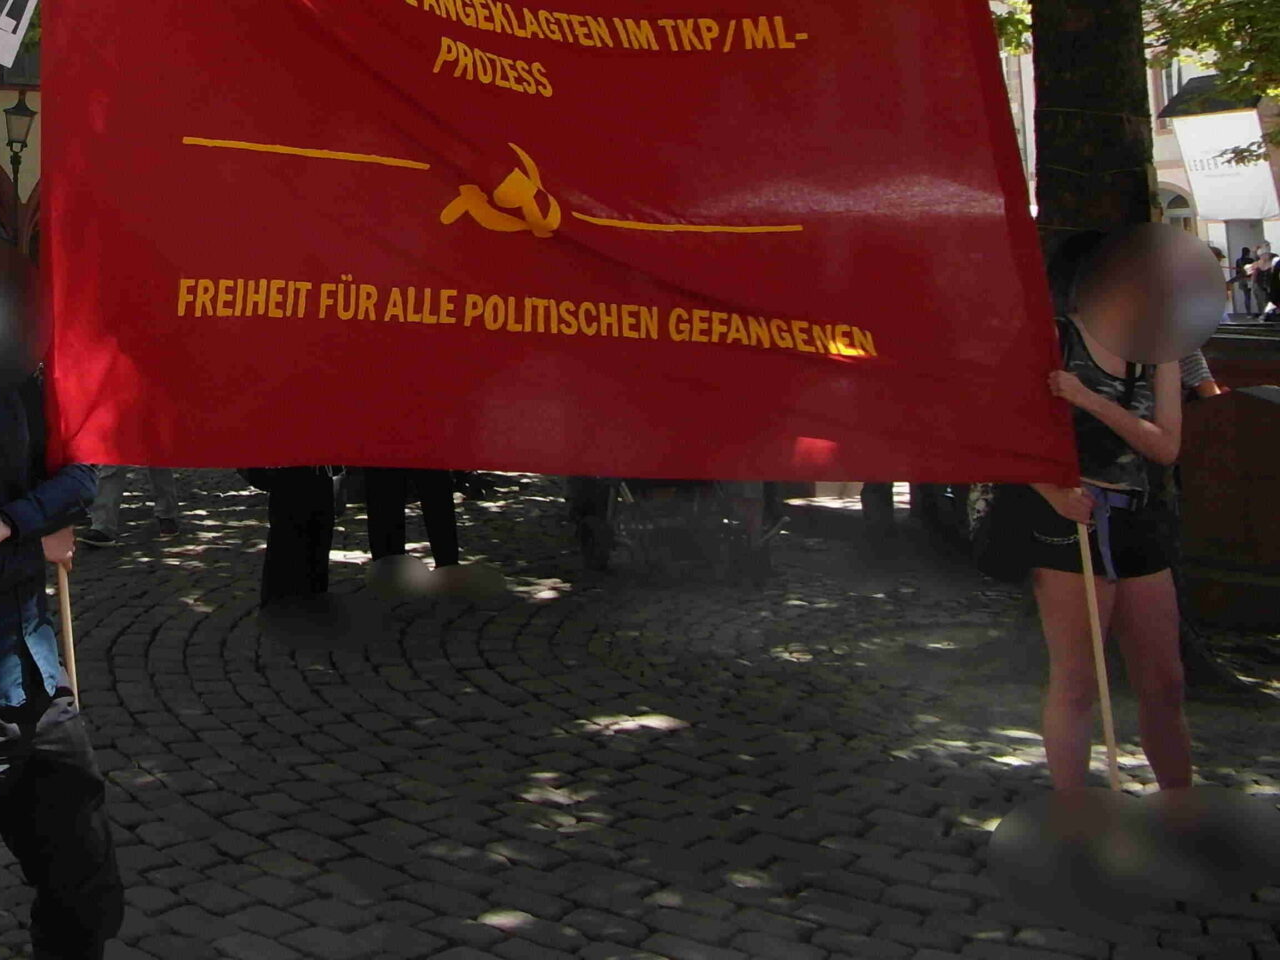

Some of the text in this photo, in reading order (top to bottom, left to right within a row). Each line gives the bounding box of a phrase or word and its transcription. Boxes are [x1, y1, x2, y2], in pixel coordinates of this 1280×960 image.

[613, 17, 659, 51] IM
[433, 37, 553, 97] PROZESS
[177, 274, 878, 357] FREIHEIT FÜR ALLE POLITISCHEN GEFANGENEN
